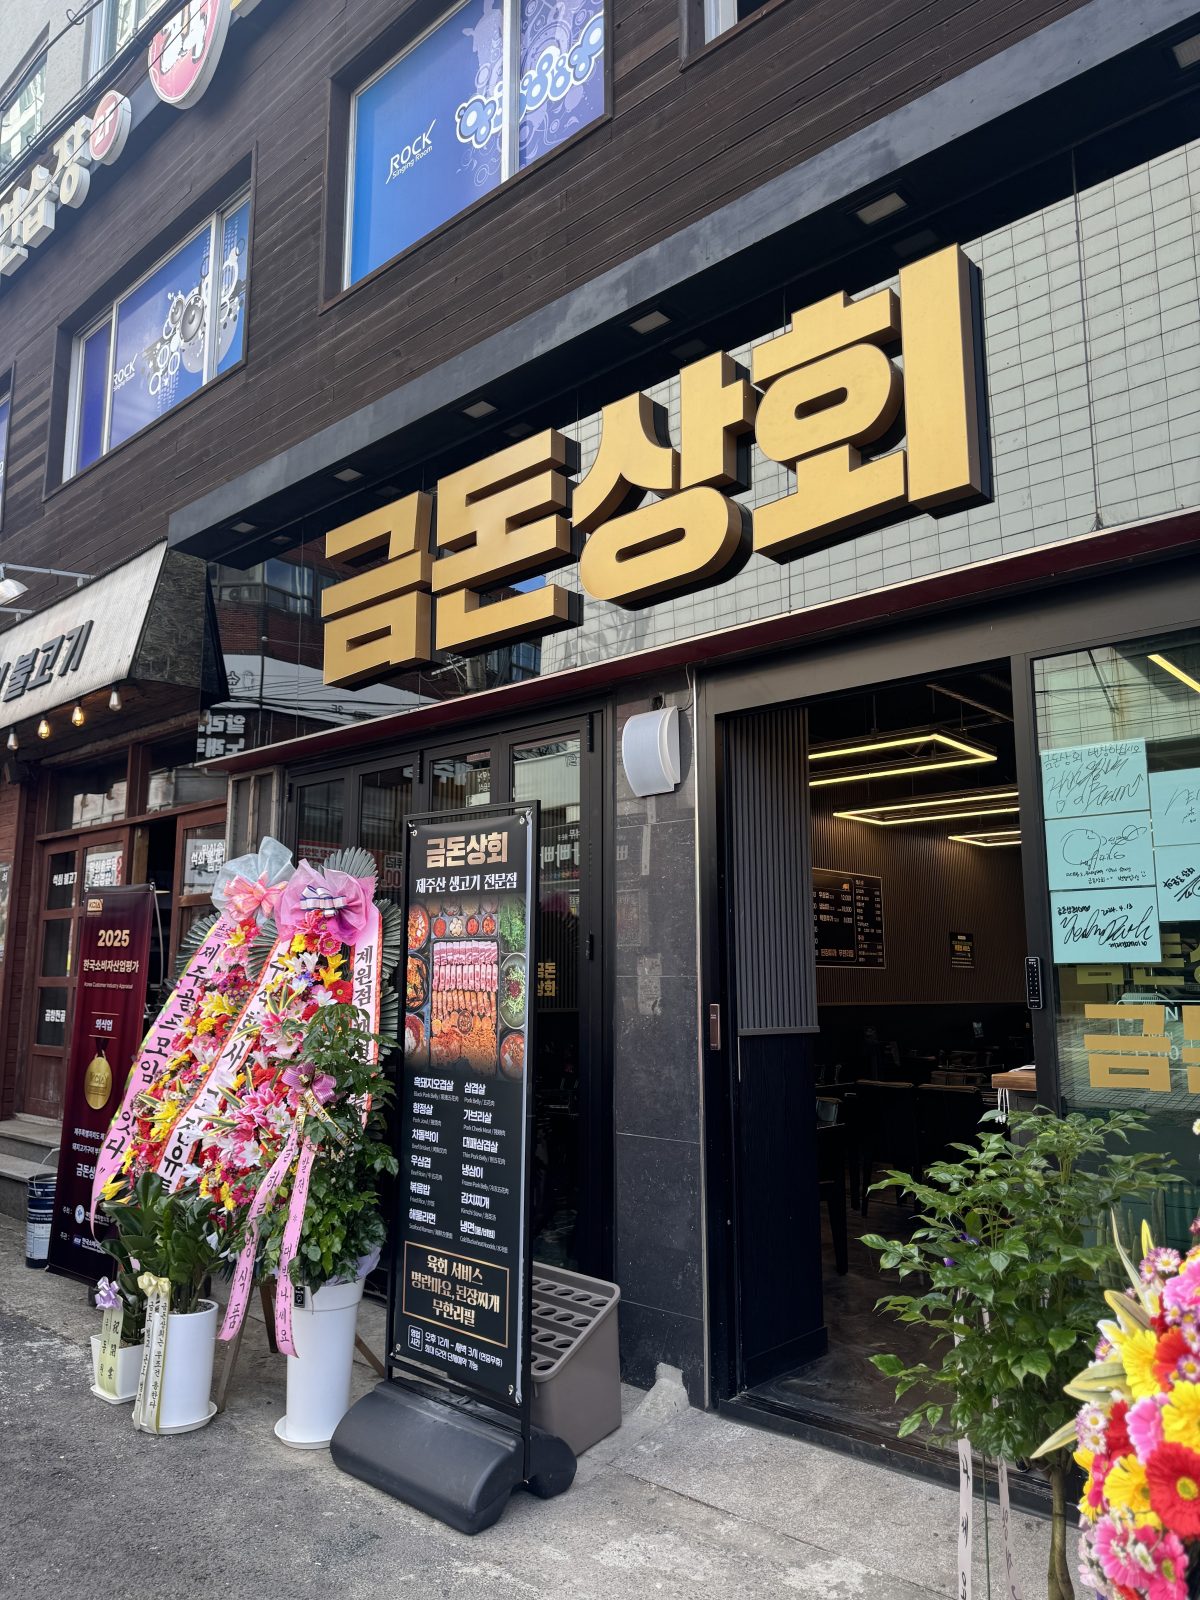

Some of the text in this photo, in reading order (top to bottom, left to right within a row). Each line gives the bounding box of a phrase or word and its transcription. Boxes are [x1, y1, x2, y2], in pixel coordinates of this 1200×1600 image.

[386, 118, 436, 185] ROCK
[392, 145, 433, 179] Singing Room
[321, 243, 990, 689] 금돈상회
[3, 620, 94, 702] 불고기
[1043, 743, 1142, 771] 금돈상회 번창하십시오
[426, 832, 508, 868] 금돈상회
[415, 877, 446, 893] 제주산
[449, 874, 481, 892] 생고기
[484, 872, 518, 889] 전문점
[97, 929, 130, 947] 2025
[83, 959, 139, 974] 한국소비자산업평가
[353, 945, 373, 1007] 제원점
[413, 1077, 454, 1092] 흑돼지오겹살
[464, 1082, 486, 1096] 삼겹살
[412, 1102, 433, 1115] 항정살
[463, 1109, 492, 1124] 가브리살
[411, 1128, 439, 1143] 차돌박이
[462, 1136, 498, 1154] 대패삼겹살
[410, 1154, 431, 1169] 우삼겹
[461, 1163, 484, 1179] 냉삼이
[409, 1181, 431, 1196] 볶음밥
[460, 1192, 489, 1210] 김치찌개
[408, 1208, 436, 1226] 해물라면
[427, 1254, 484, 1285] 육회 서비스
[411, 1271, 500, 1314] 명란마요, 된장찌개
[432, 1298, 475, 1328] 무한리필
[411, 1328, 421, 1339] 영업
[424, 1331, 437, 1345] 오후
[410, 1338, 421, 1348] 시간
